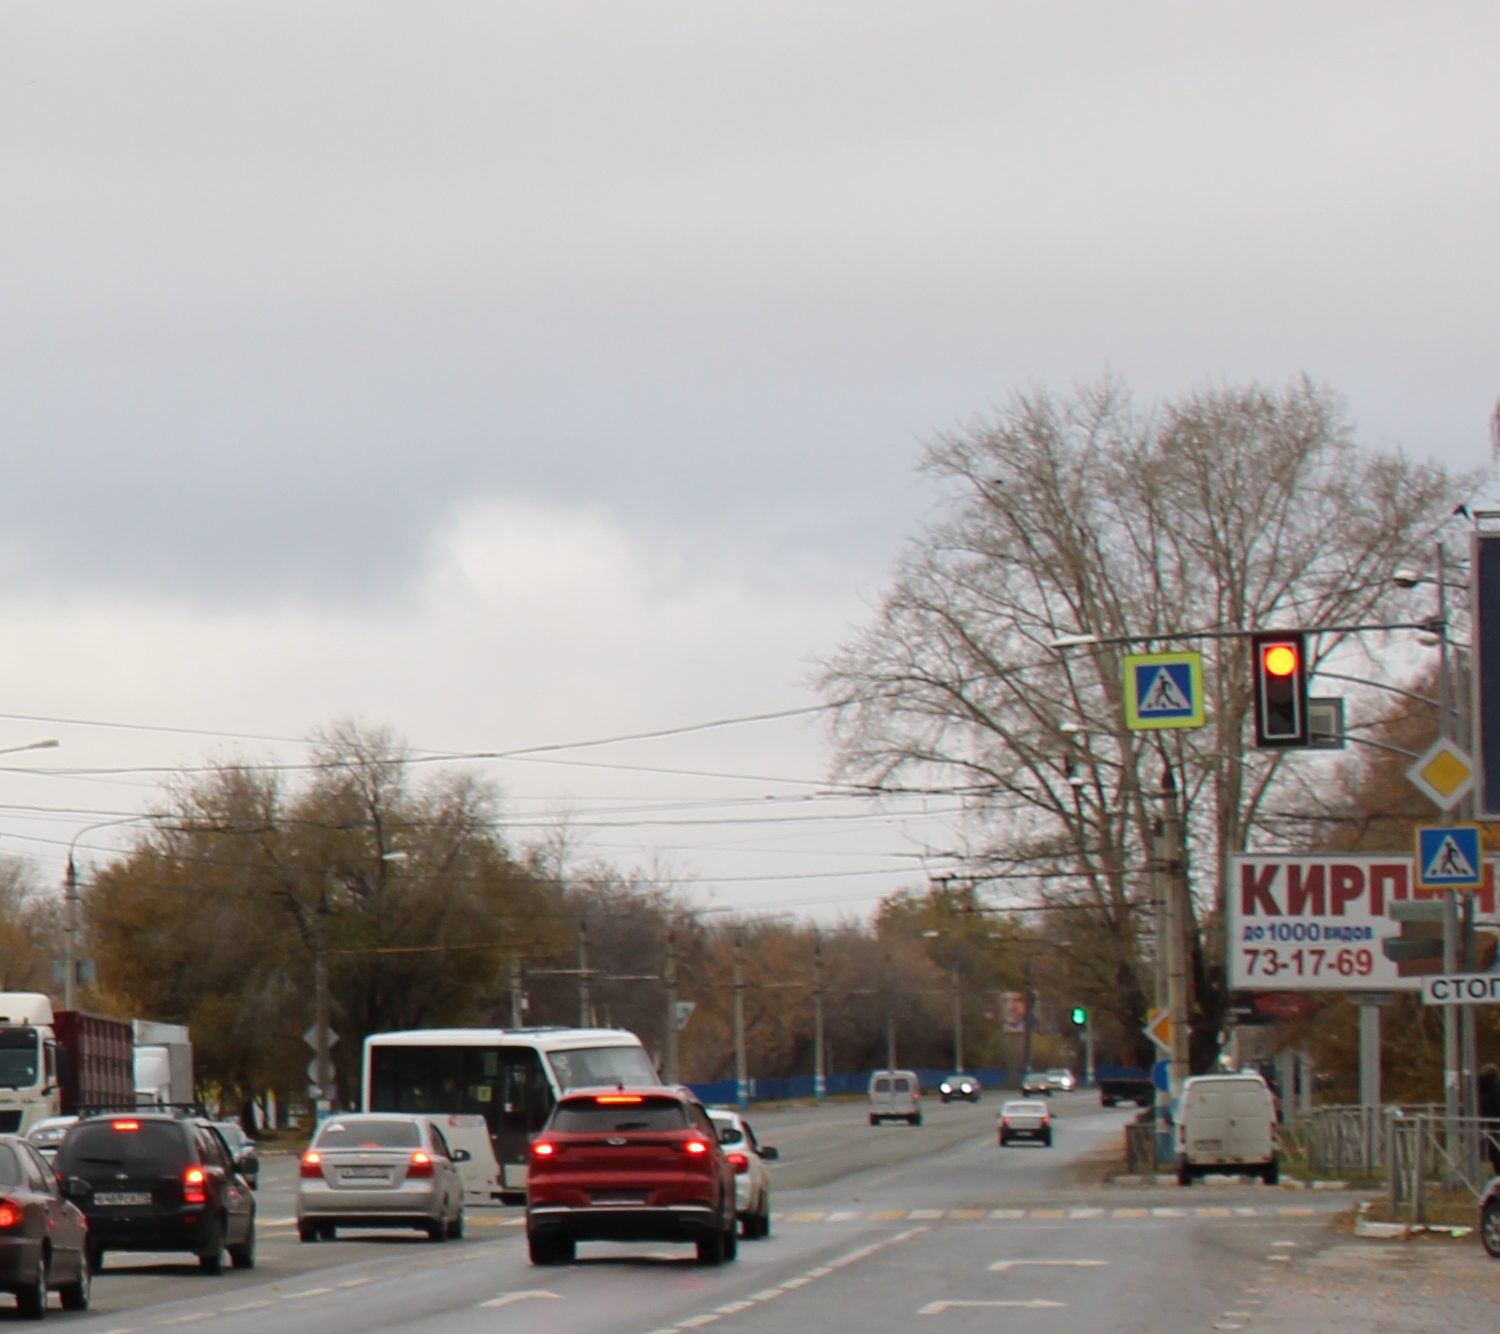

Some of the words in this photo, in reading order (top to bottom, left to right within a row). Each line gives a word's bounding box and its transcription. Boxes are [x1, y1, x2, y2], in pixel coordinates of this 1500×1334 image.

[1241, 864, 1495, 916] КИРП
[1243, 925, 1264, 942] до
[1270, 923, 1321, 942] 1000
[1323, 926, 1373, 942] видов
[1243, 949, 1373, 976] 73-17-69
